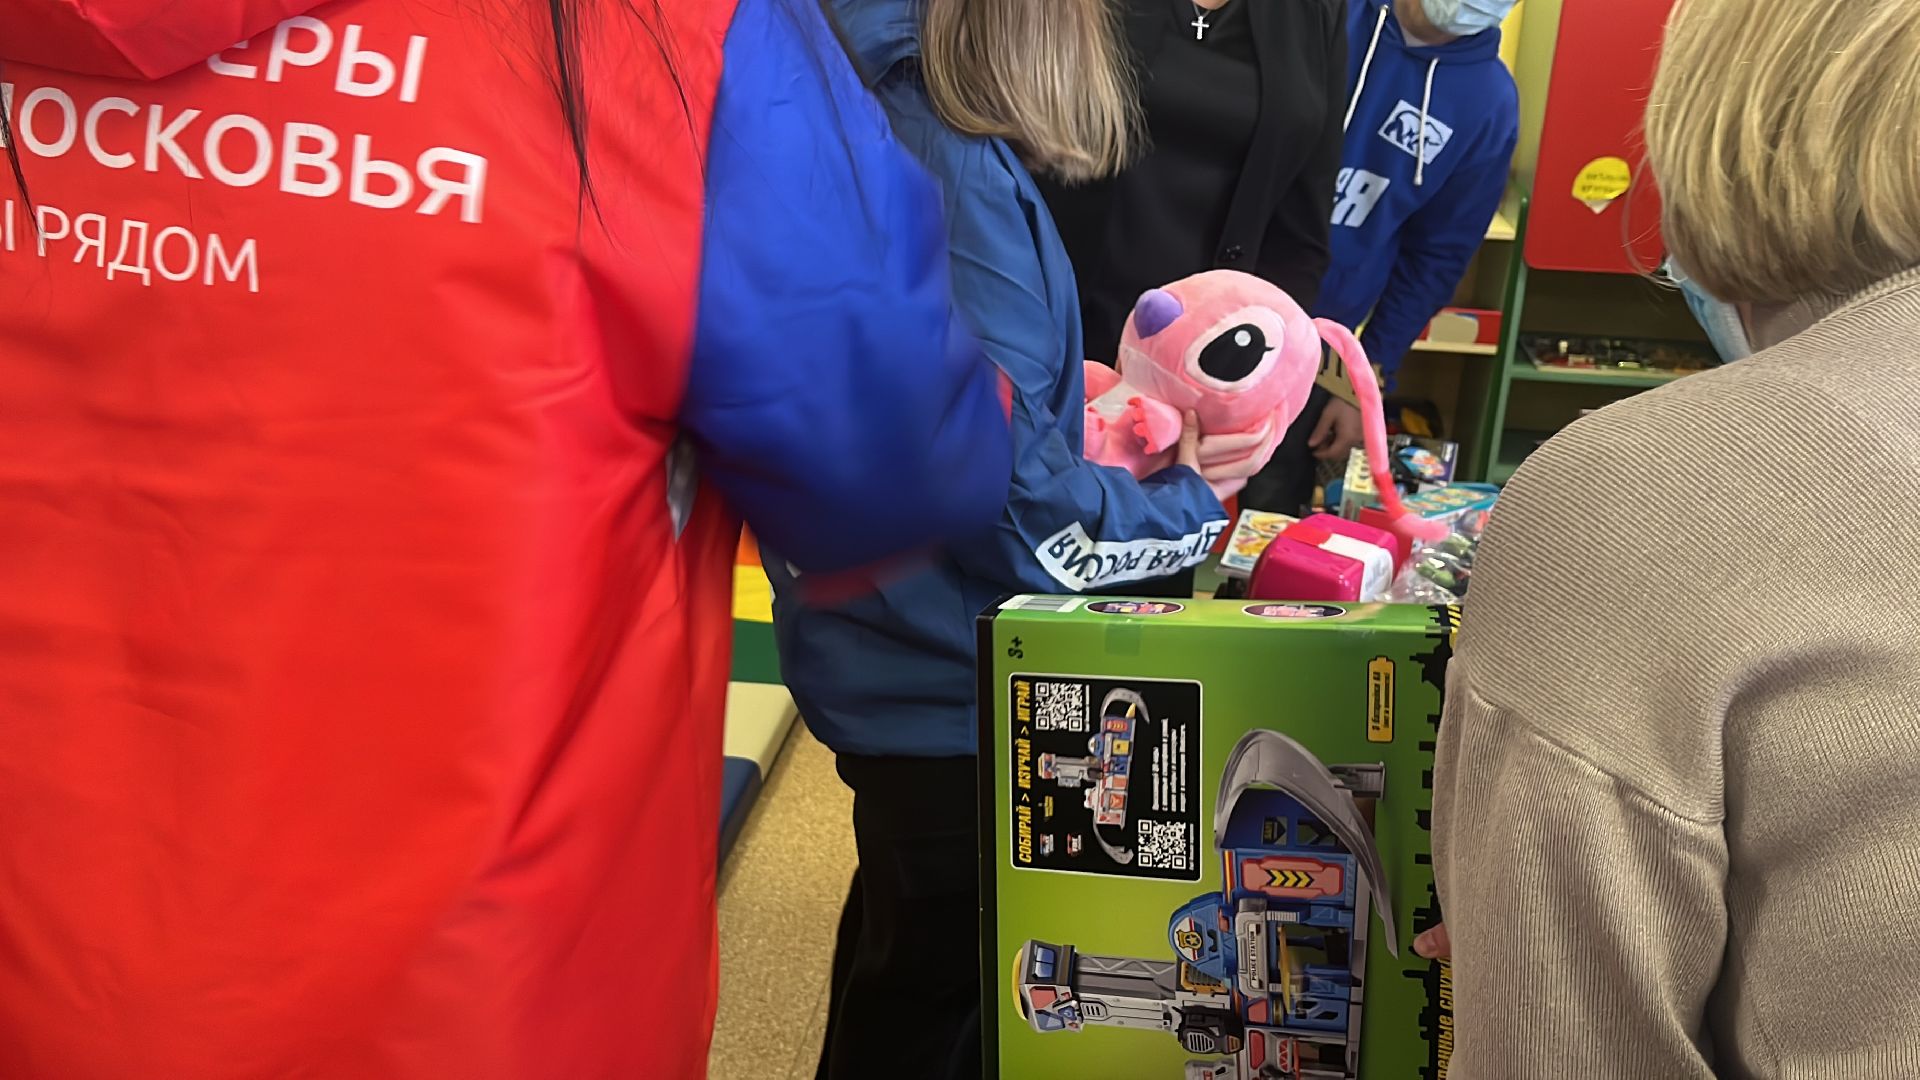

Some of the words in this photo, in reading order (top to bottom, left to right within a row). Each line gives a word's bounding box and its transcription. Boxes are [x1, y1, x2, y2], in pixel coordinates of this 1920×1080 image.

[0, 82, 488, 224] ОСКОВЬЯ
[36, 204, 260, 293] РЯДОМ
[1048, 532, 1146, 583] РОССИЯ
[1013, 680, 1031, 722] ИГРАЙ
[1015, 805, 1032, 863] СОБИРАЙ
[1249, 931, 1257, 957] STATION
